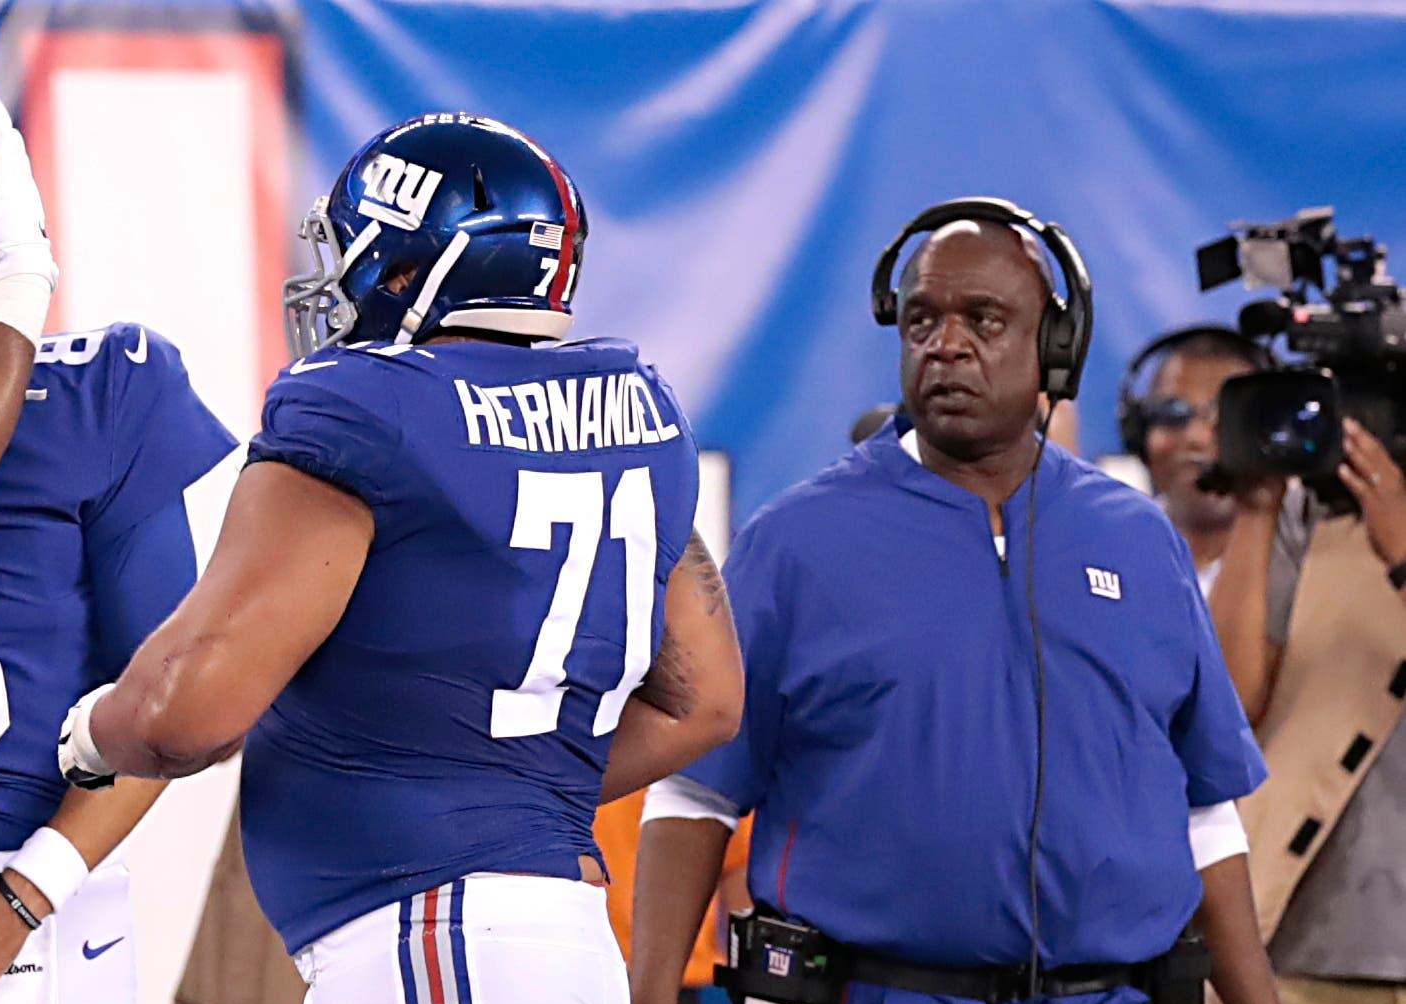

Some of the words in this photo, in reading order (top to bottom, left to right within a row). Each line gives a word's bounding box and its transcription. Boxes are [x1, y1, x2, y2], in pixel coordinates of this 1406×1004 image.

[357, 153, 443, 232] ny
[533, 256, 577, 301] 71
[490, 466, 657, 738] 71
[1085, 567, 1121, 600] ny
